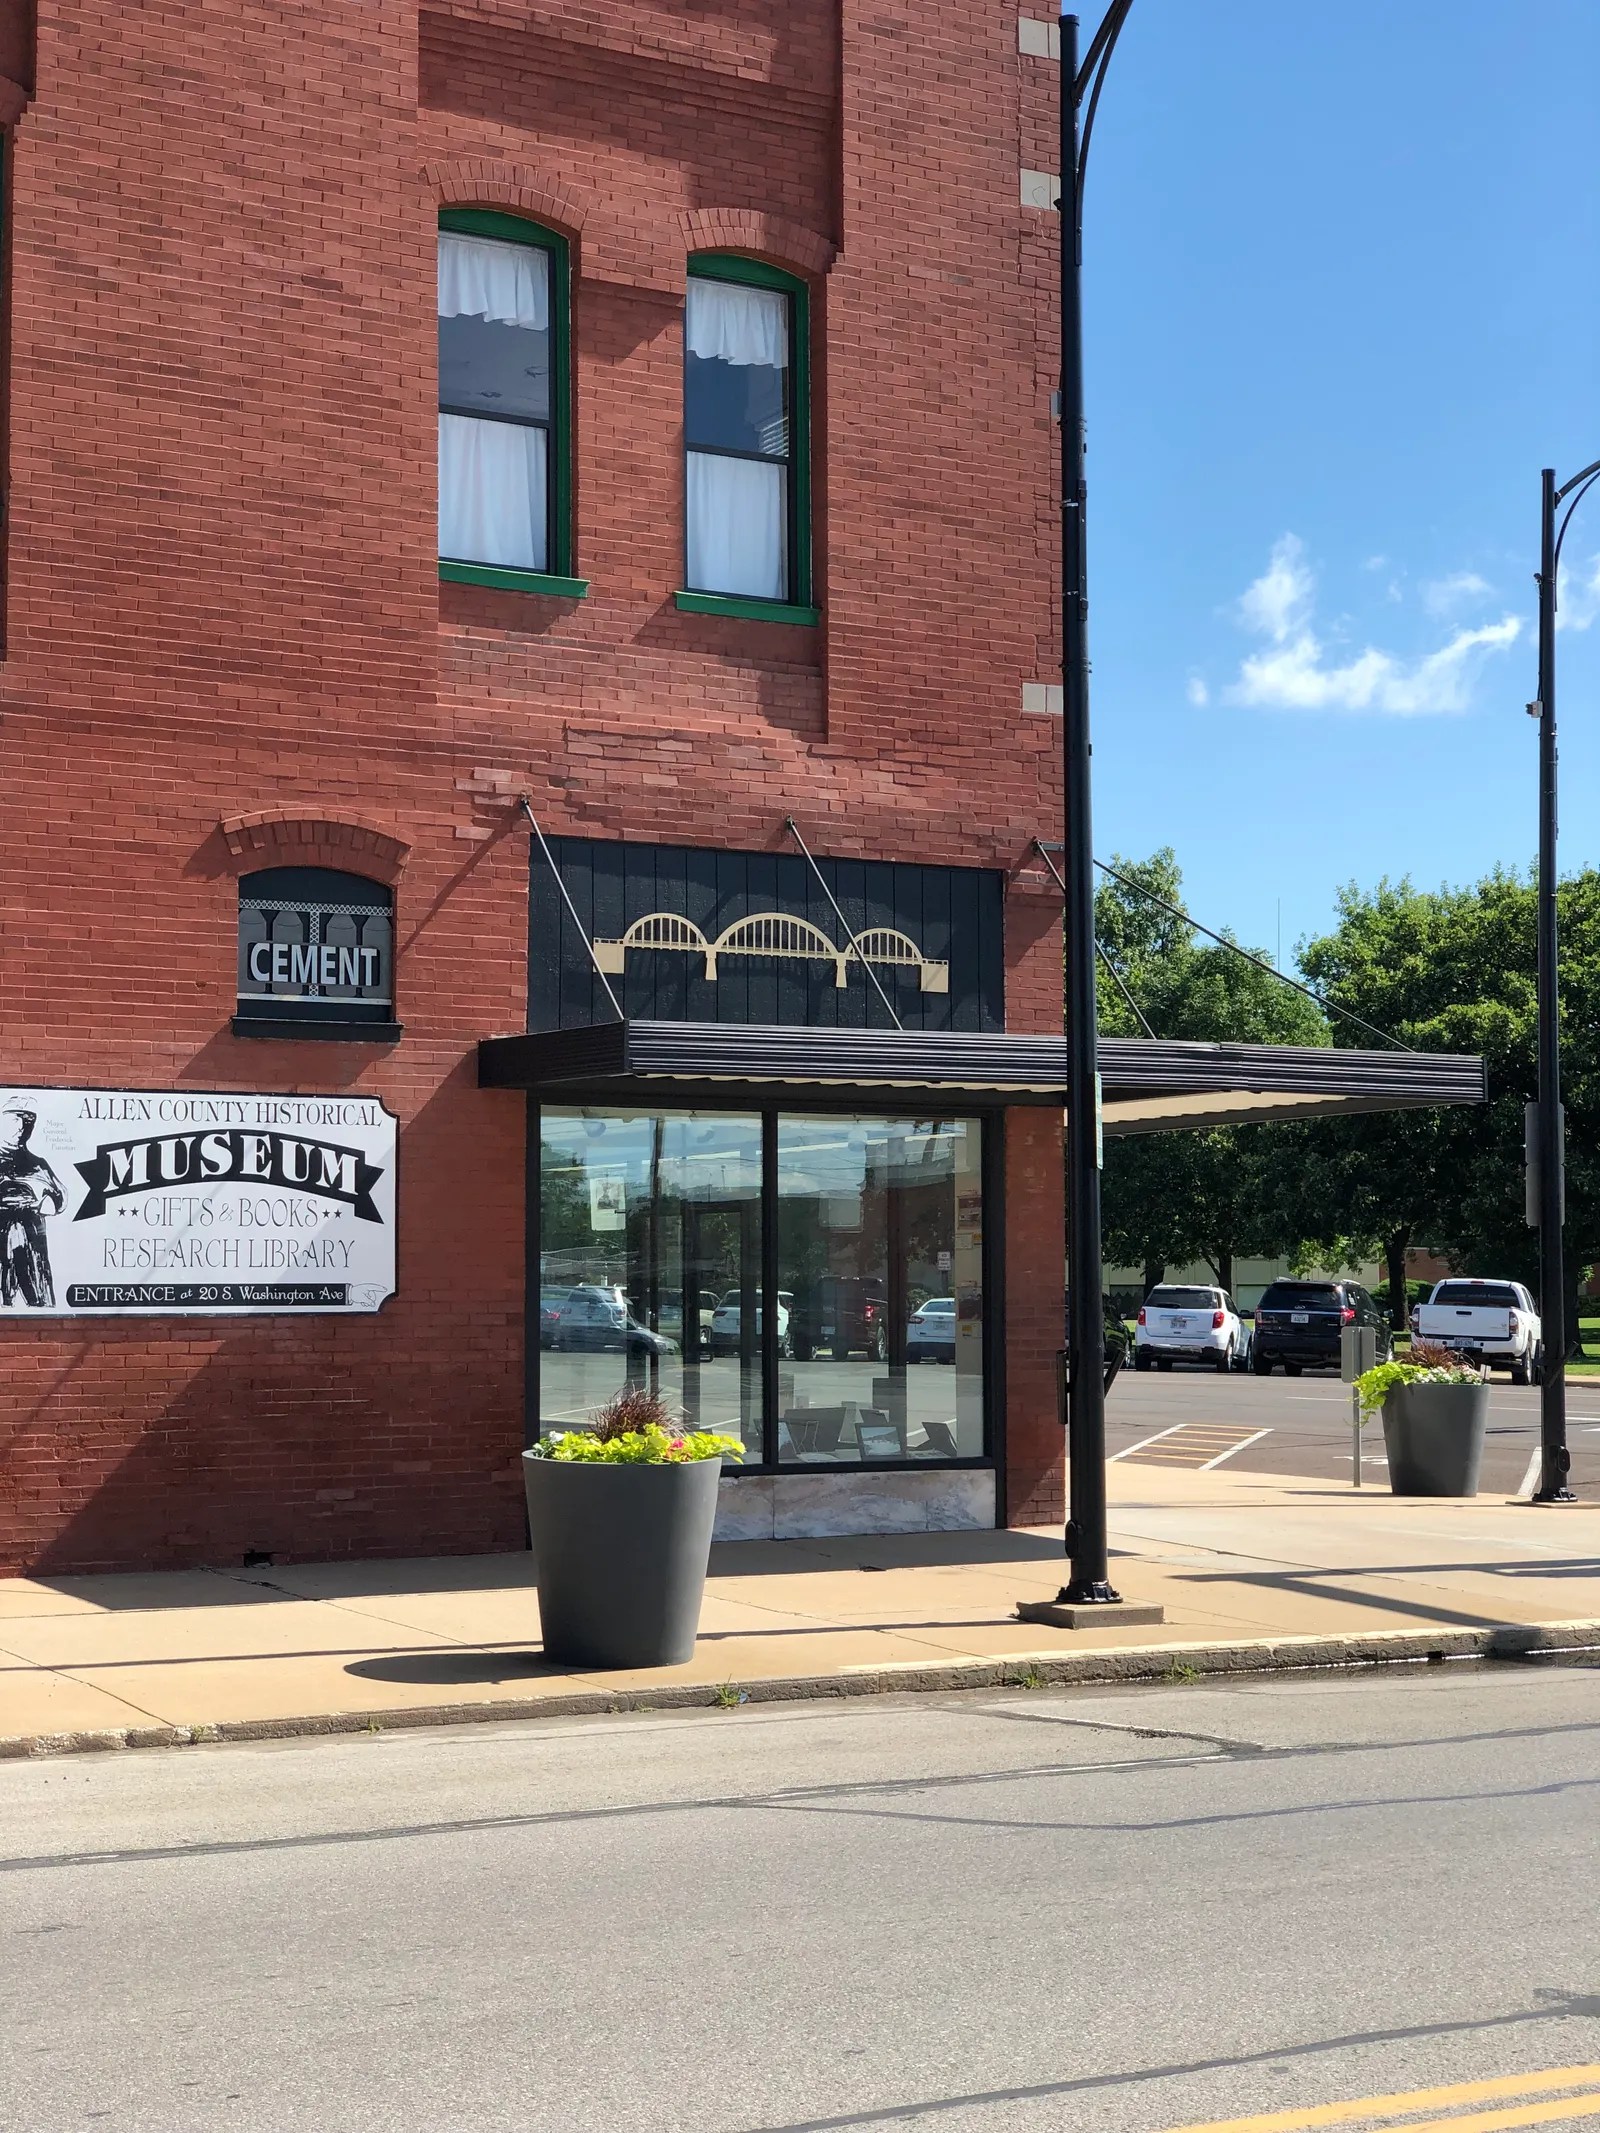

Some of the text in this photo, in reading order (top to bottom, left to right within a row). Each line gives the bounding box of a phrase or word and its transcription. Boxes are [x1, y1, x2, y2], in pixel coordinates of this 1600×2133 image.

[250, 942, 378, 987] CEMENT
[78, 1097, 383, 1127] ALLEN COUNTY HISTORICAL
[103, 1130, 359, 1195] MUSEUM
[143, 1197, 318, 1227] GIFTS & BOOKS
[103, 1238, 356, 1269] RESEARCH LIBRARY
[74, 1286, 344, 1306] ENTRANCE at 20 S. Washington Ave
